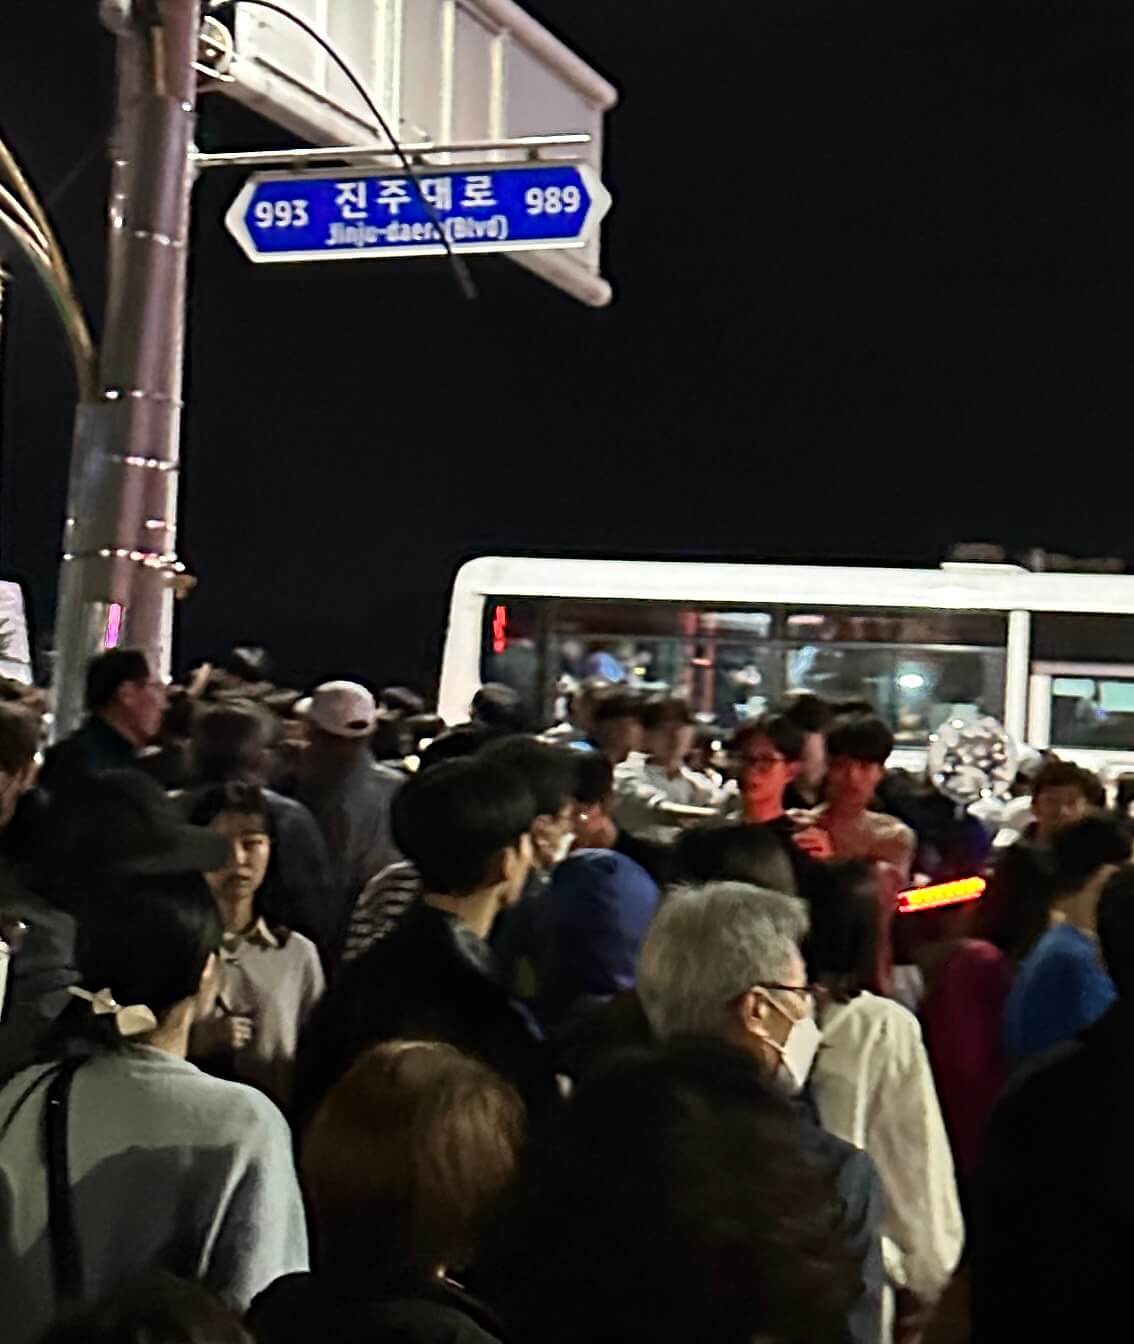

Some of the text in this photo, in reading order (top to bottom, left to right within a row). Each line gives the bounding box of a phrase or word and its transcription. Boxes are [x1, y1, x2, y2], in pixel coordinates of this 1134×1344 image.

[335, 175, 498, 219] 진주대로
[525, 186, 581, 216] 989
[254, 200, 309, 229] 993
